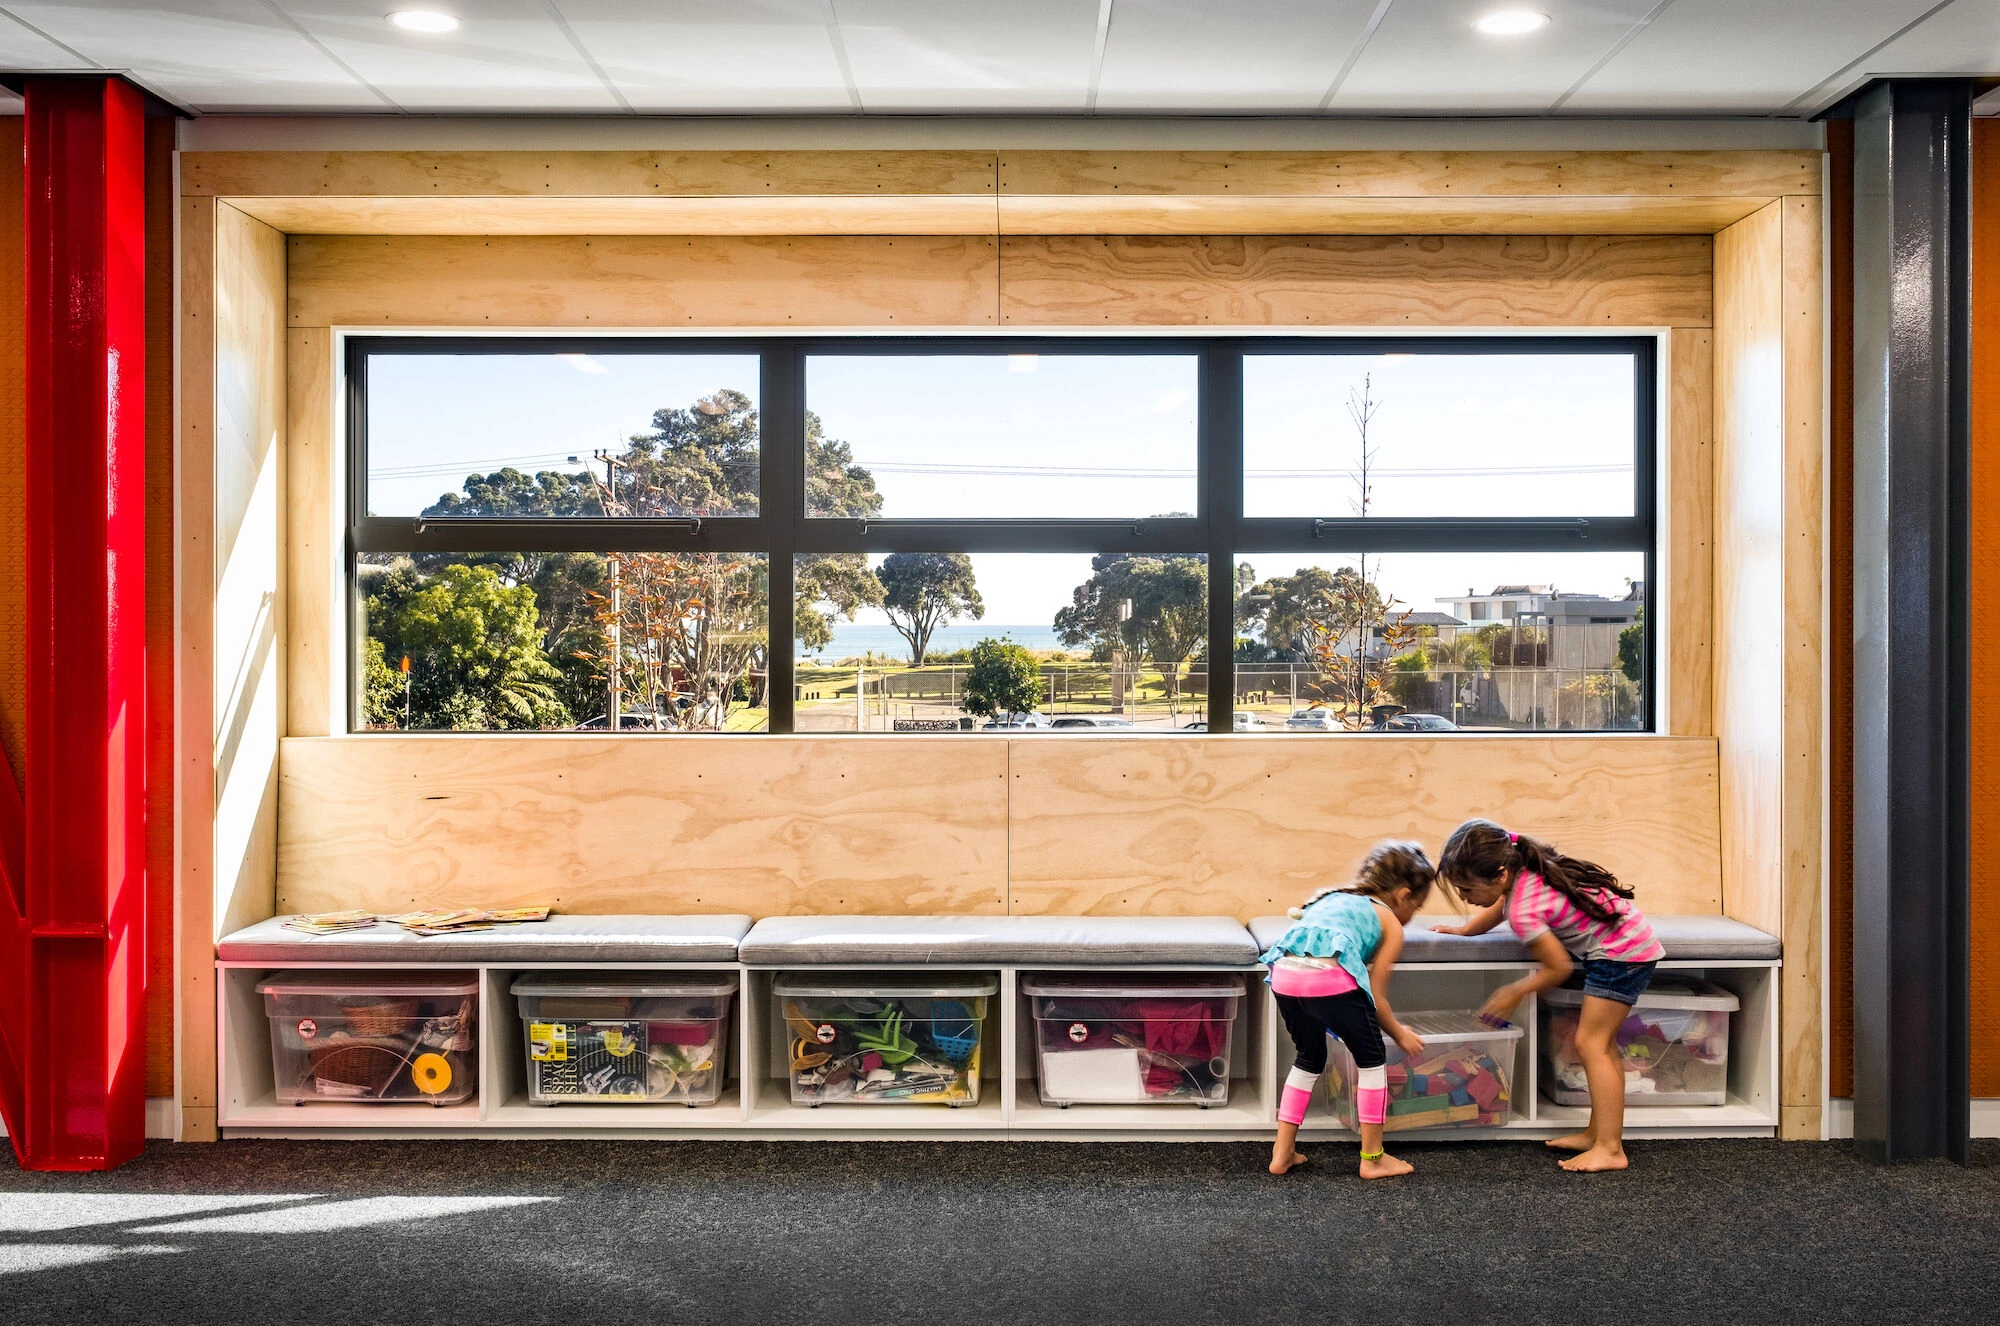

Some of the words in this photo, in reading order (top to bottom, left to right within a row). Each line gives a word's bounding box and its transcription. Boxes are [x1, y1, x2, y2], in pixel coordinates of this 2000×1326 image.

[565, 1024, 577, 1093] SHUTTLE
[543, 1060, 552, 1075] TH
[543, 1076, 552, 1093] FLY
[552, 1060, 565, 1093] SPAC
[915, 1085, 942, 1093] AMAZING
